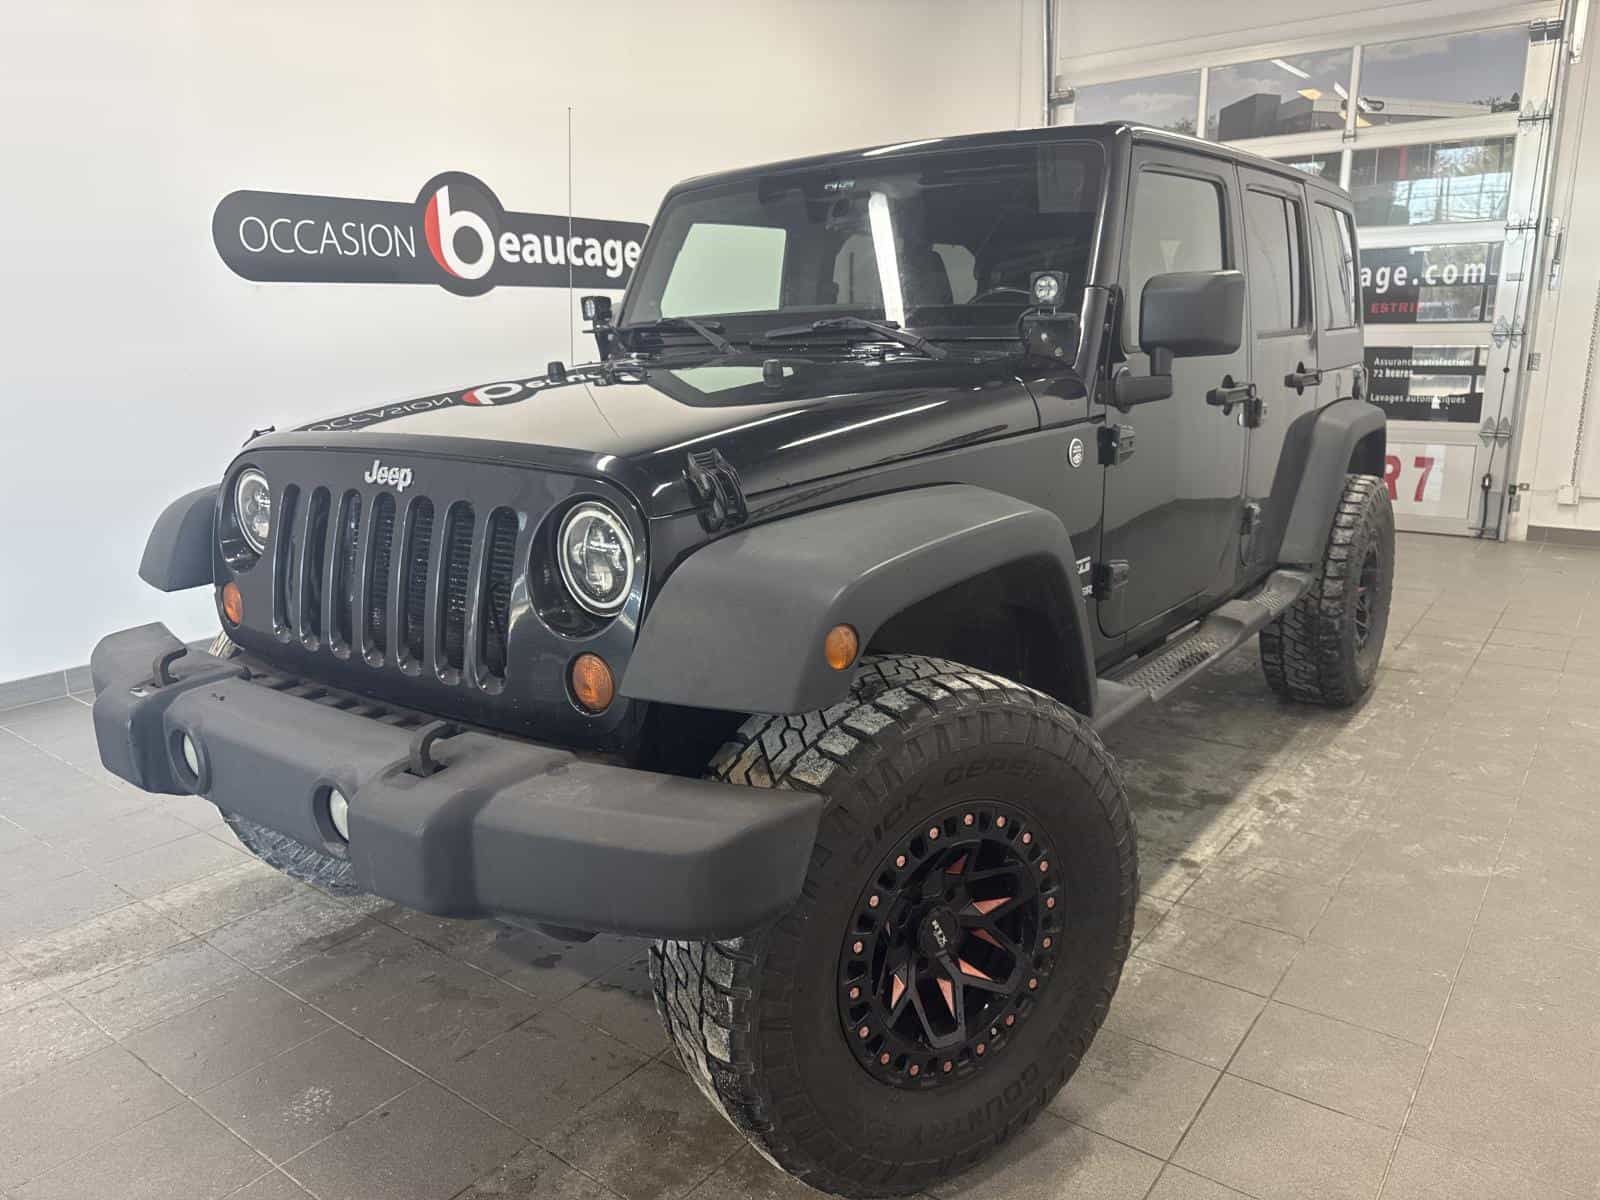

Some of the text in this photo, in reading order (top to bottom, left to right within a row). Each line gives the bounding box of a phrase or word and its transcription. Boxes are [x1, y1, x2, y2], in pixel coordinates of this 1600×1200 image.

[239, 217, 416, 258] OCCASION
[1373, 369, 1384, 378] 72
[364, 459, 413, 492] Jeep
